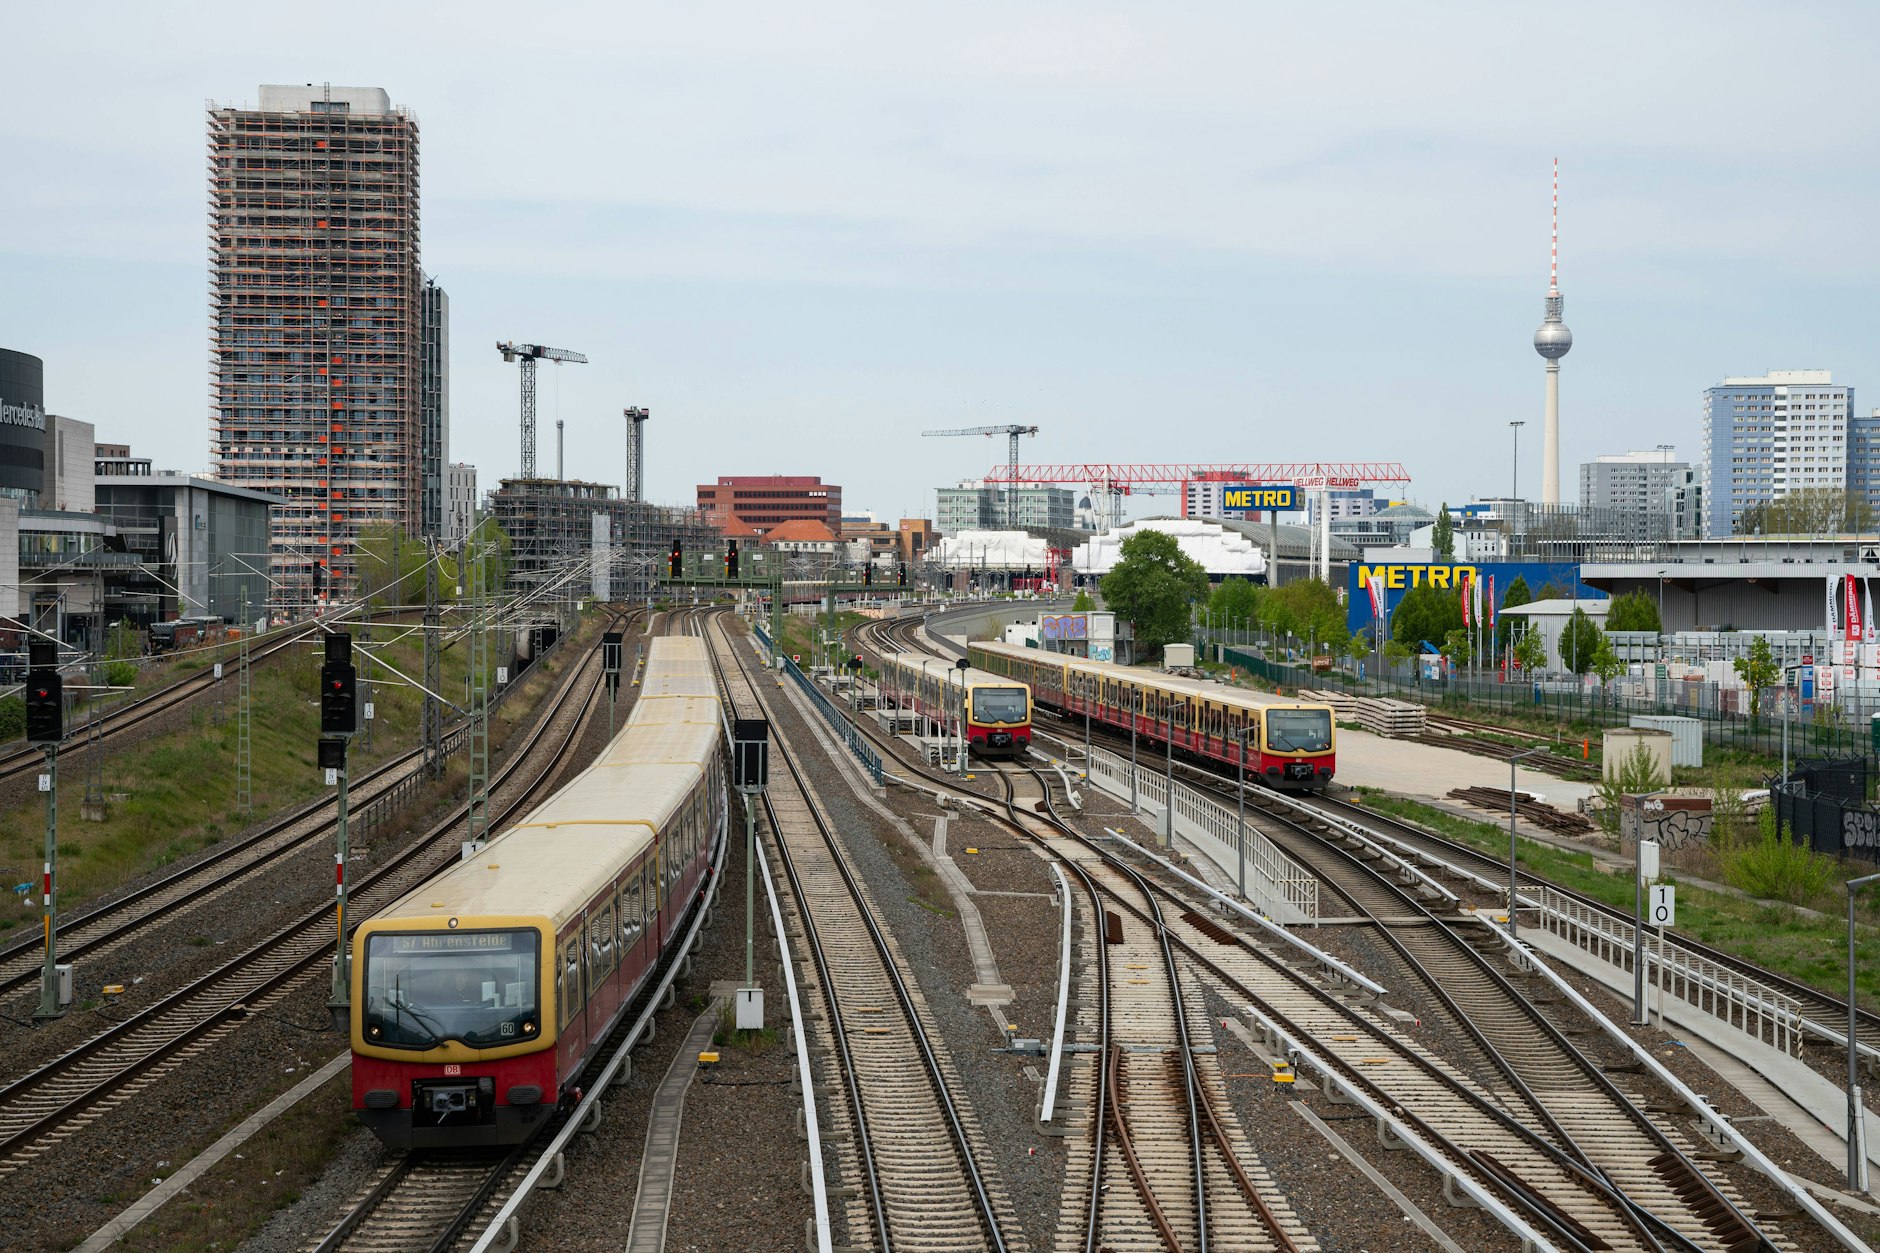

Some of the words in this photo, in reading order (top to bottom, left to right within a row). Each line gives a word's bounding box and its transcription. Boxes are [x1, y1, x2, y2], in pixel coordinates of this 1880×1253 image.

[1293, 477, 1323, 486] HELLWEG
[1326, 477, 1359, 487] HELLWEG
[1225, 490, 1291, 507] METRO
[1358, 565, 1477, 589] METRO
[1660, 888, 1665, 904] 1
[1656, 905, 1668, 922] 0
[402, 937, 416, 949] S7
[502, 1024, 514, 1034] 60
[446, 1065, 458, 1073] DB
